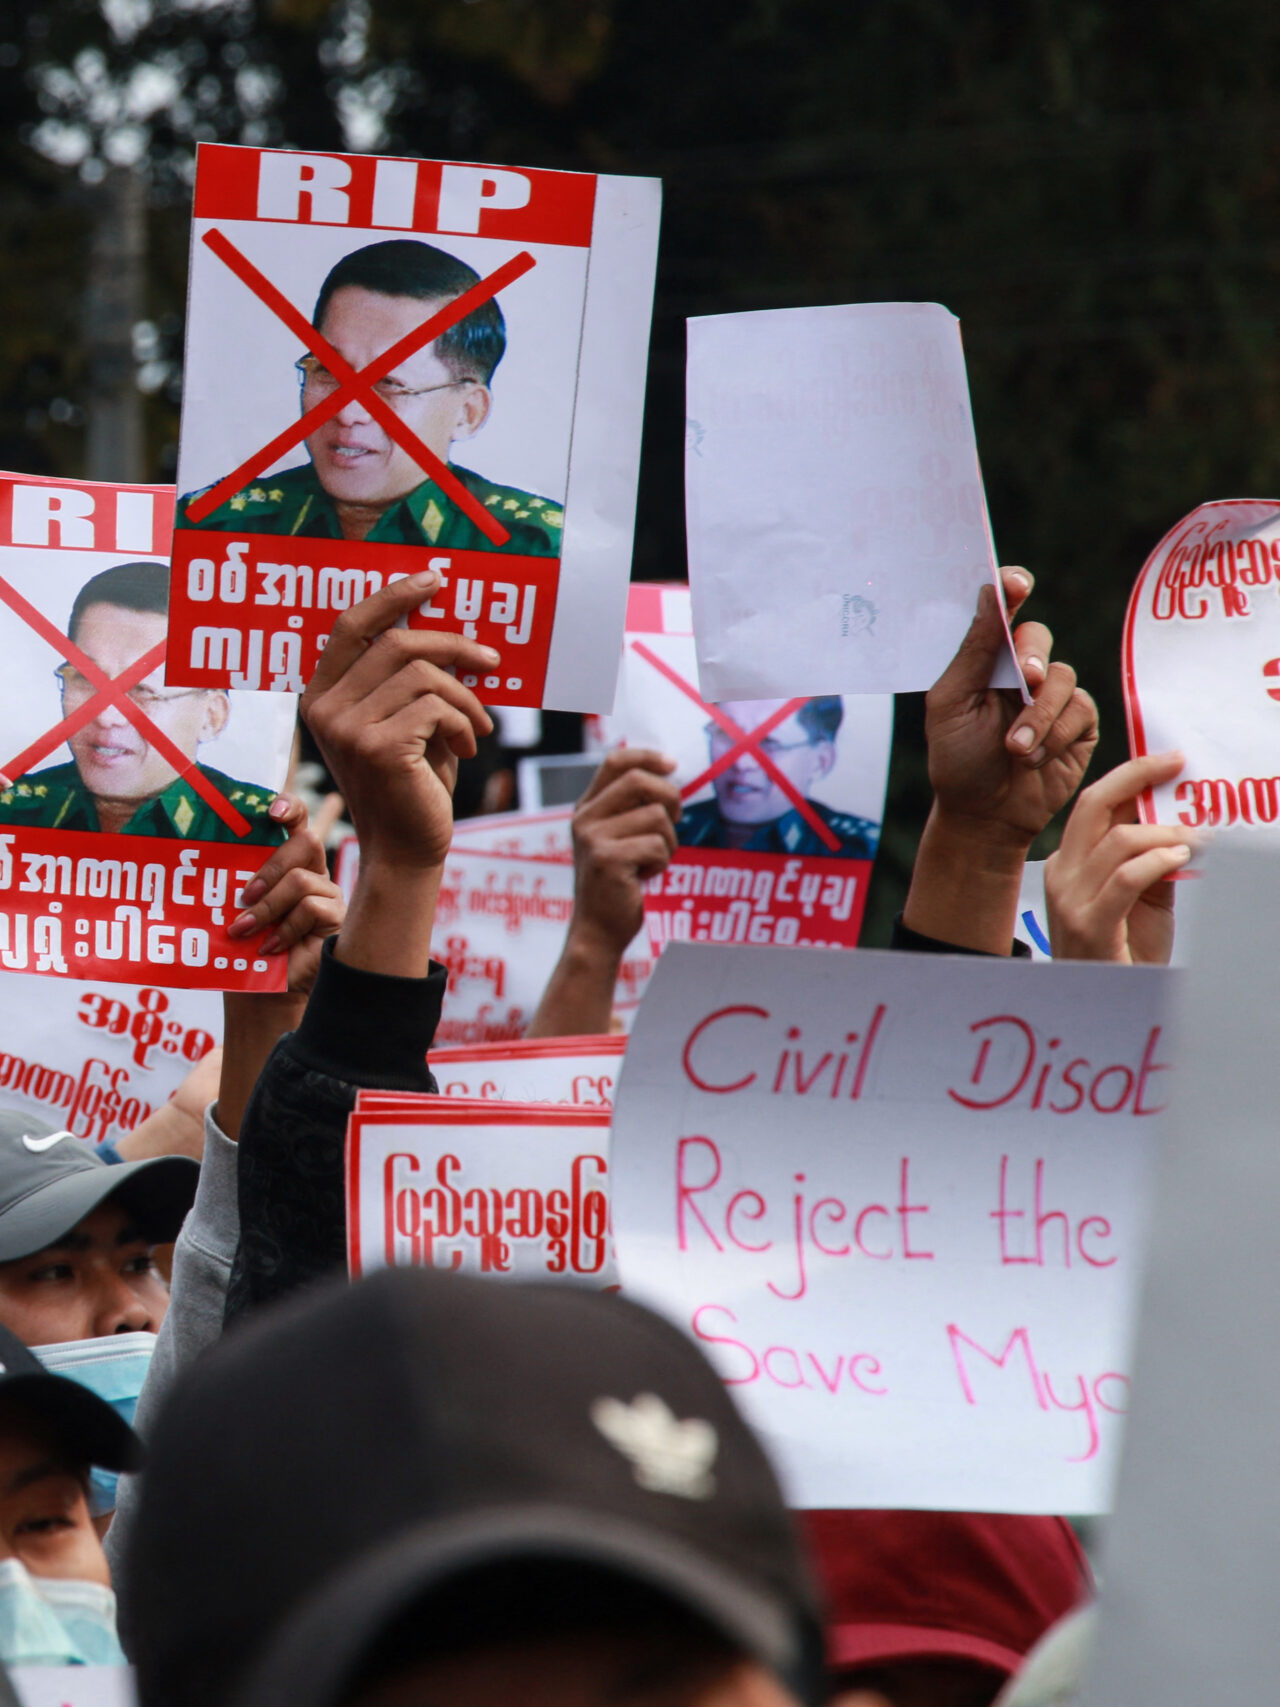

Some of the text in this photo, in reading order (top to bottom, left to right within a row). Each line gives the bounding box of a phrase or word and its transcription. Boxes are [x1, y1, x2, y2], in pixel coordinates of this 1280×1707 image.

[256, 151, 532, 234] RIP
[682, 1004, 886, 1100] Civil
[676, 1135, 1118, 1301] Reject the
[691, 1304, 888, 1396] Save
